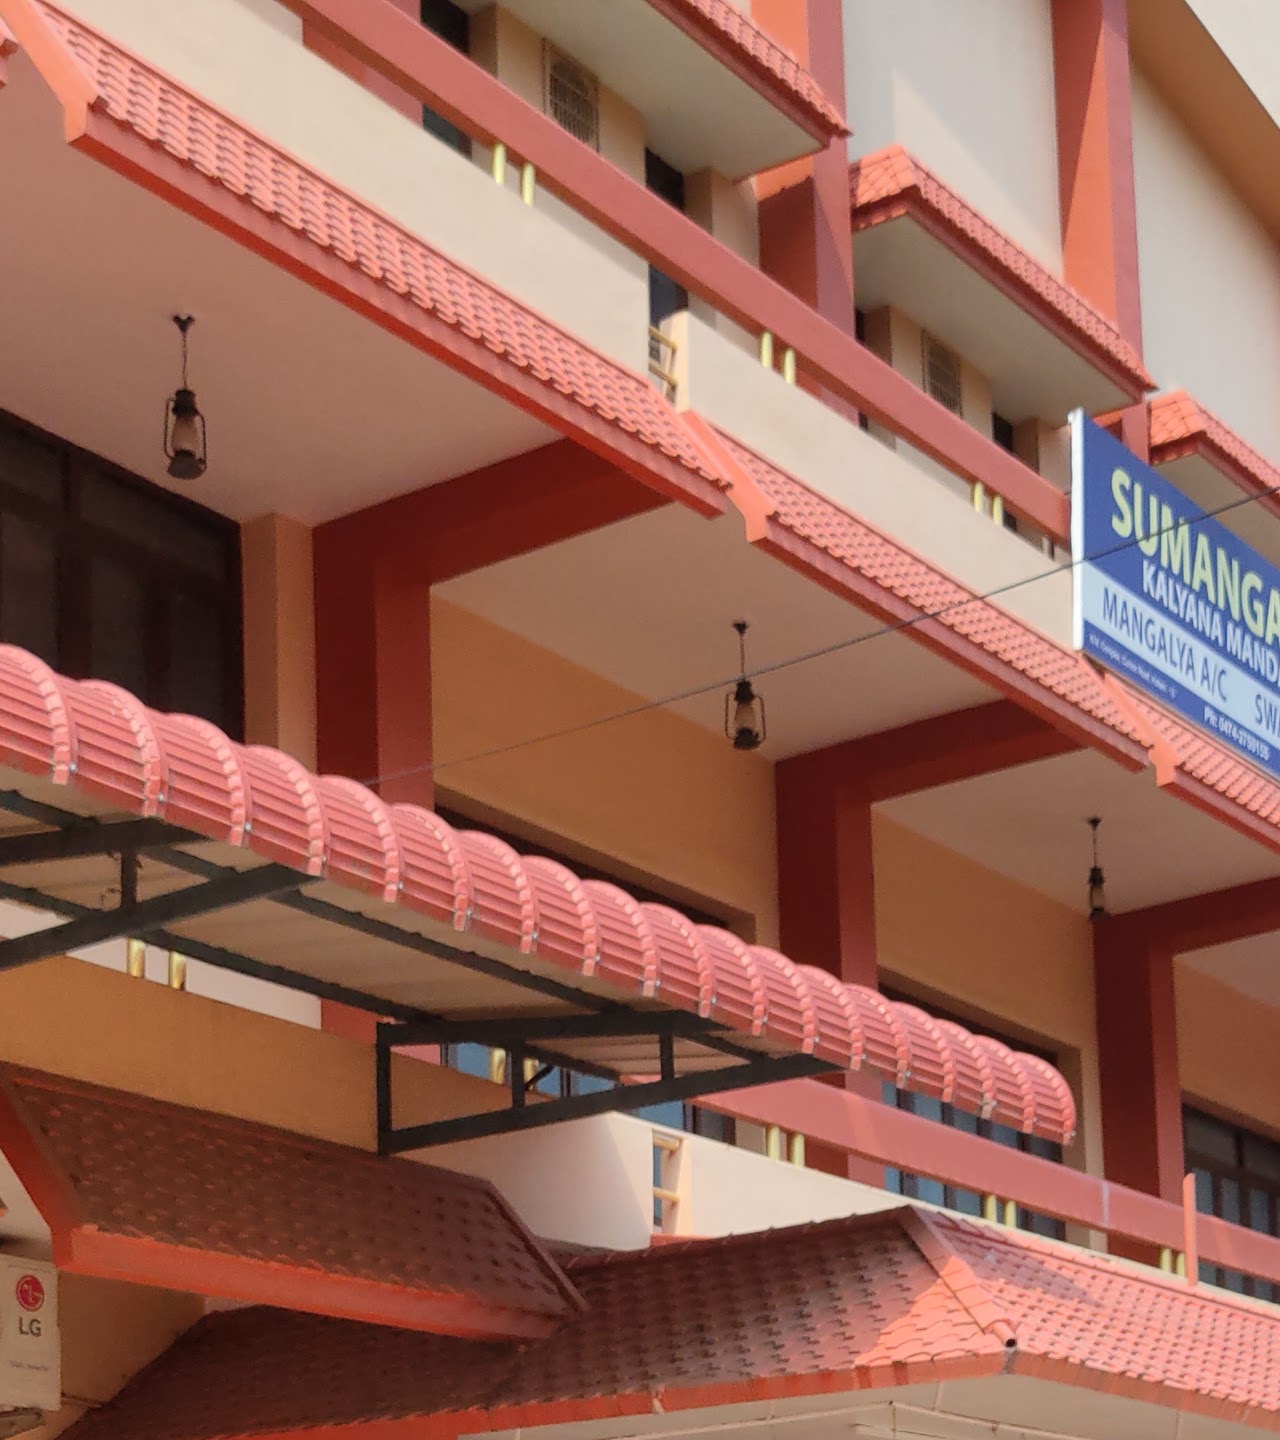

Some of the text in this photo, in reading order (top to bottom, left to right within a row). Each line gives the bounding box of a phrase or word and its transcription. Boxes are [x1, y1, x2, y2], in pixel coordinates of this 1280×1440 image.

[1103, 587, 1196, 682] MANGALYA
[1200, 657, 1227, 703] A/C
[1143, 559, 1223, 647] KALYANA
[19, 1316, 41, 1336] LG
